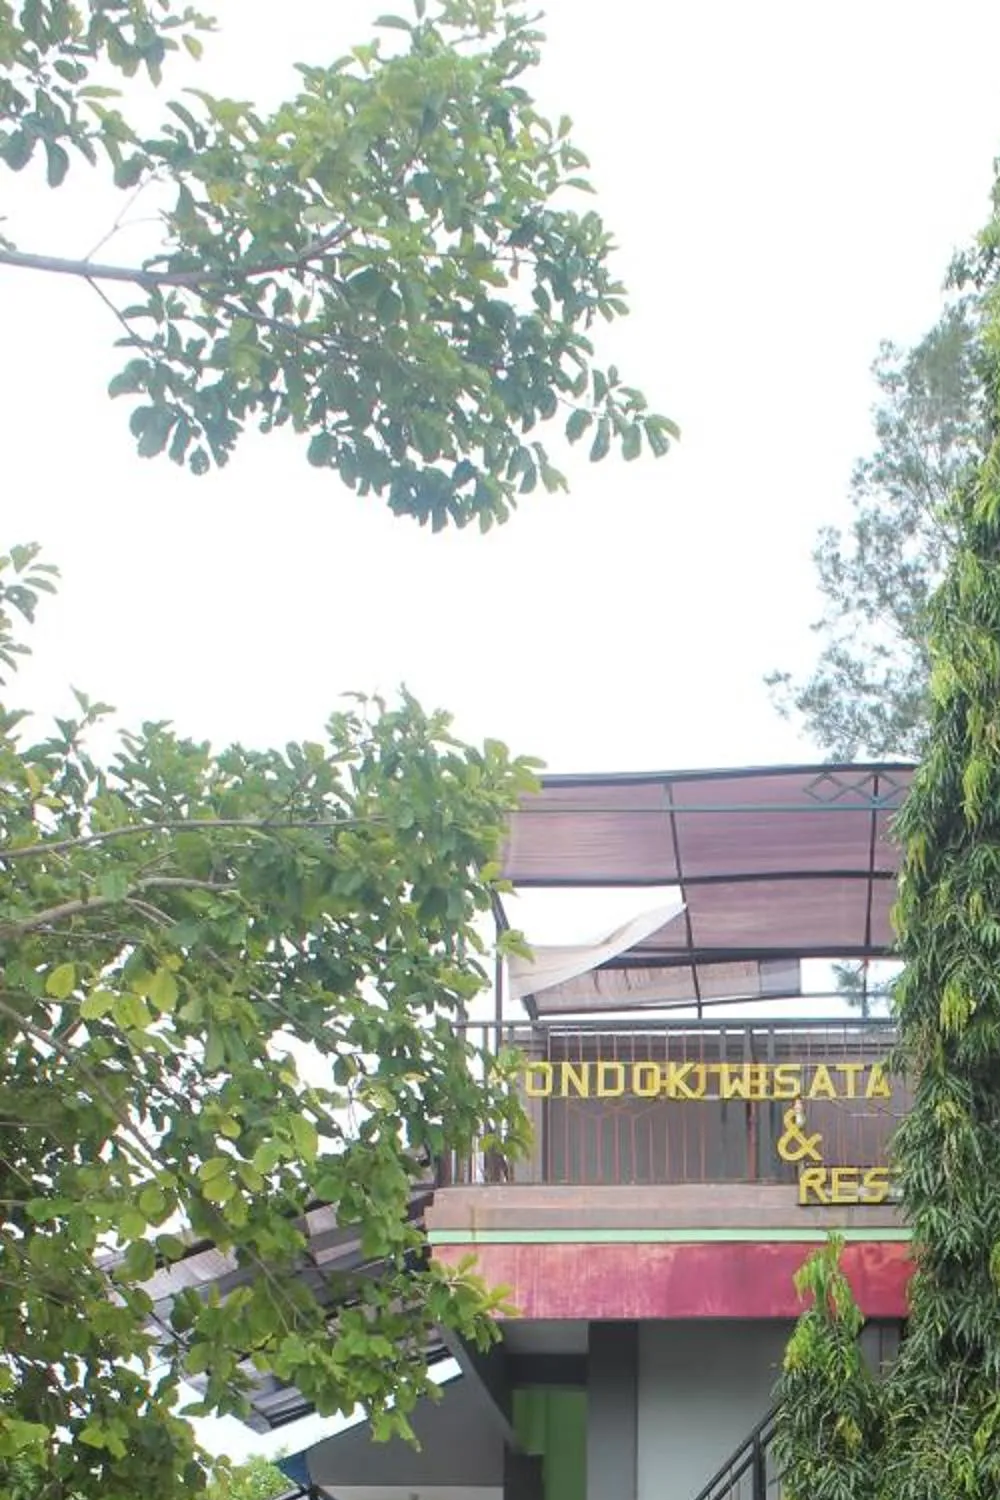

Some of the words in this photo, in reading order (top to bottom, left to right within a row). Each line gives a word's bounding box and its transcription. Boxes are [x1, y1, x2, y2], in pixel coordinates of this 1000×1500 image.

[490, 1061, 702, 1099] ONDOK
[720, 1062, 892, 1099] WISATA
[777, 1108, 824, 1162] &
[800, 1167, 890, 1204] RES
